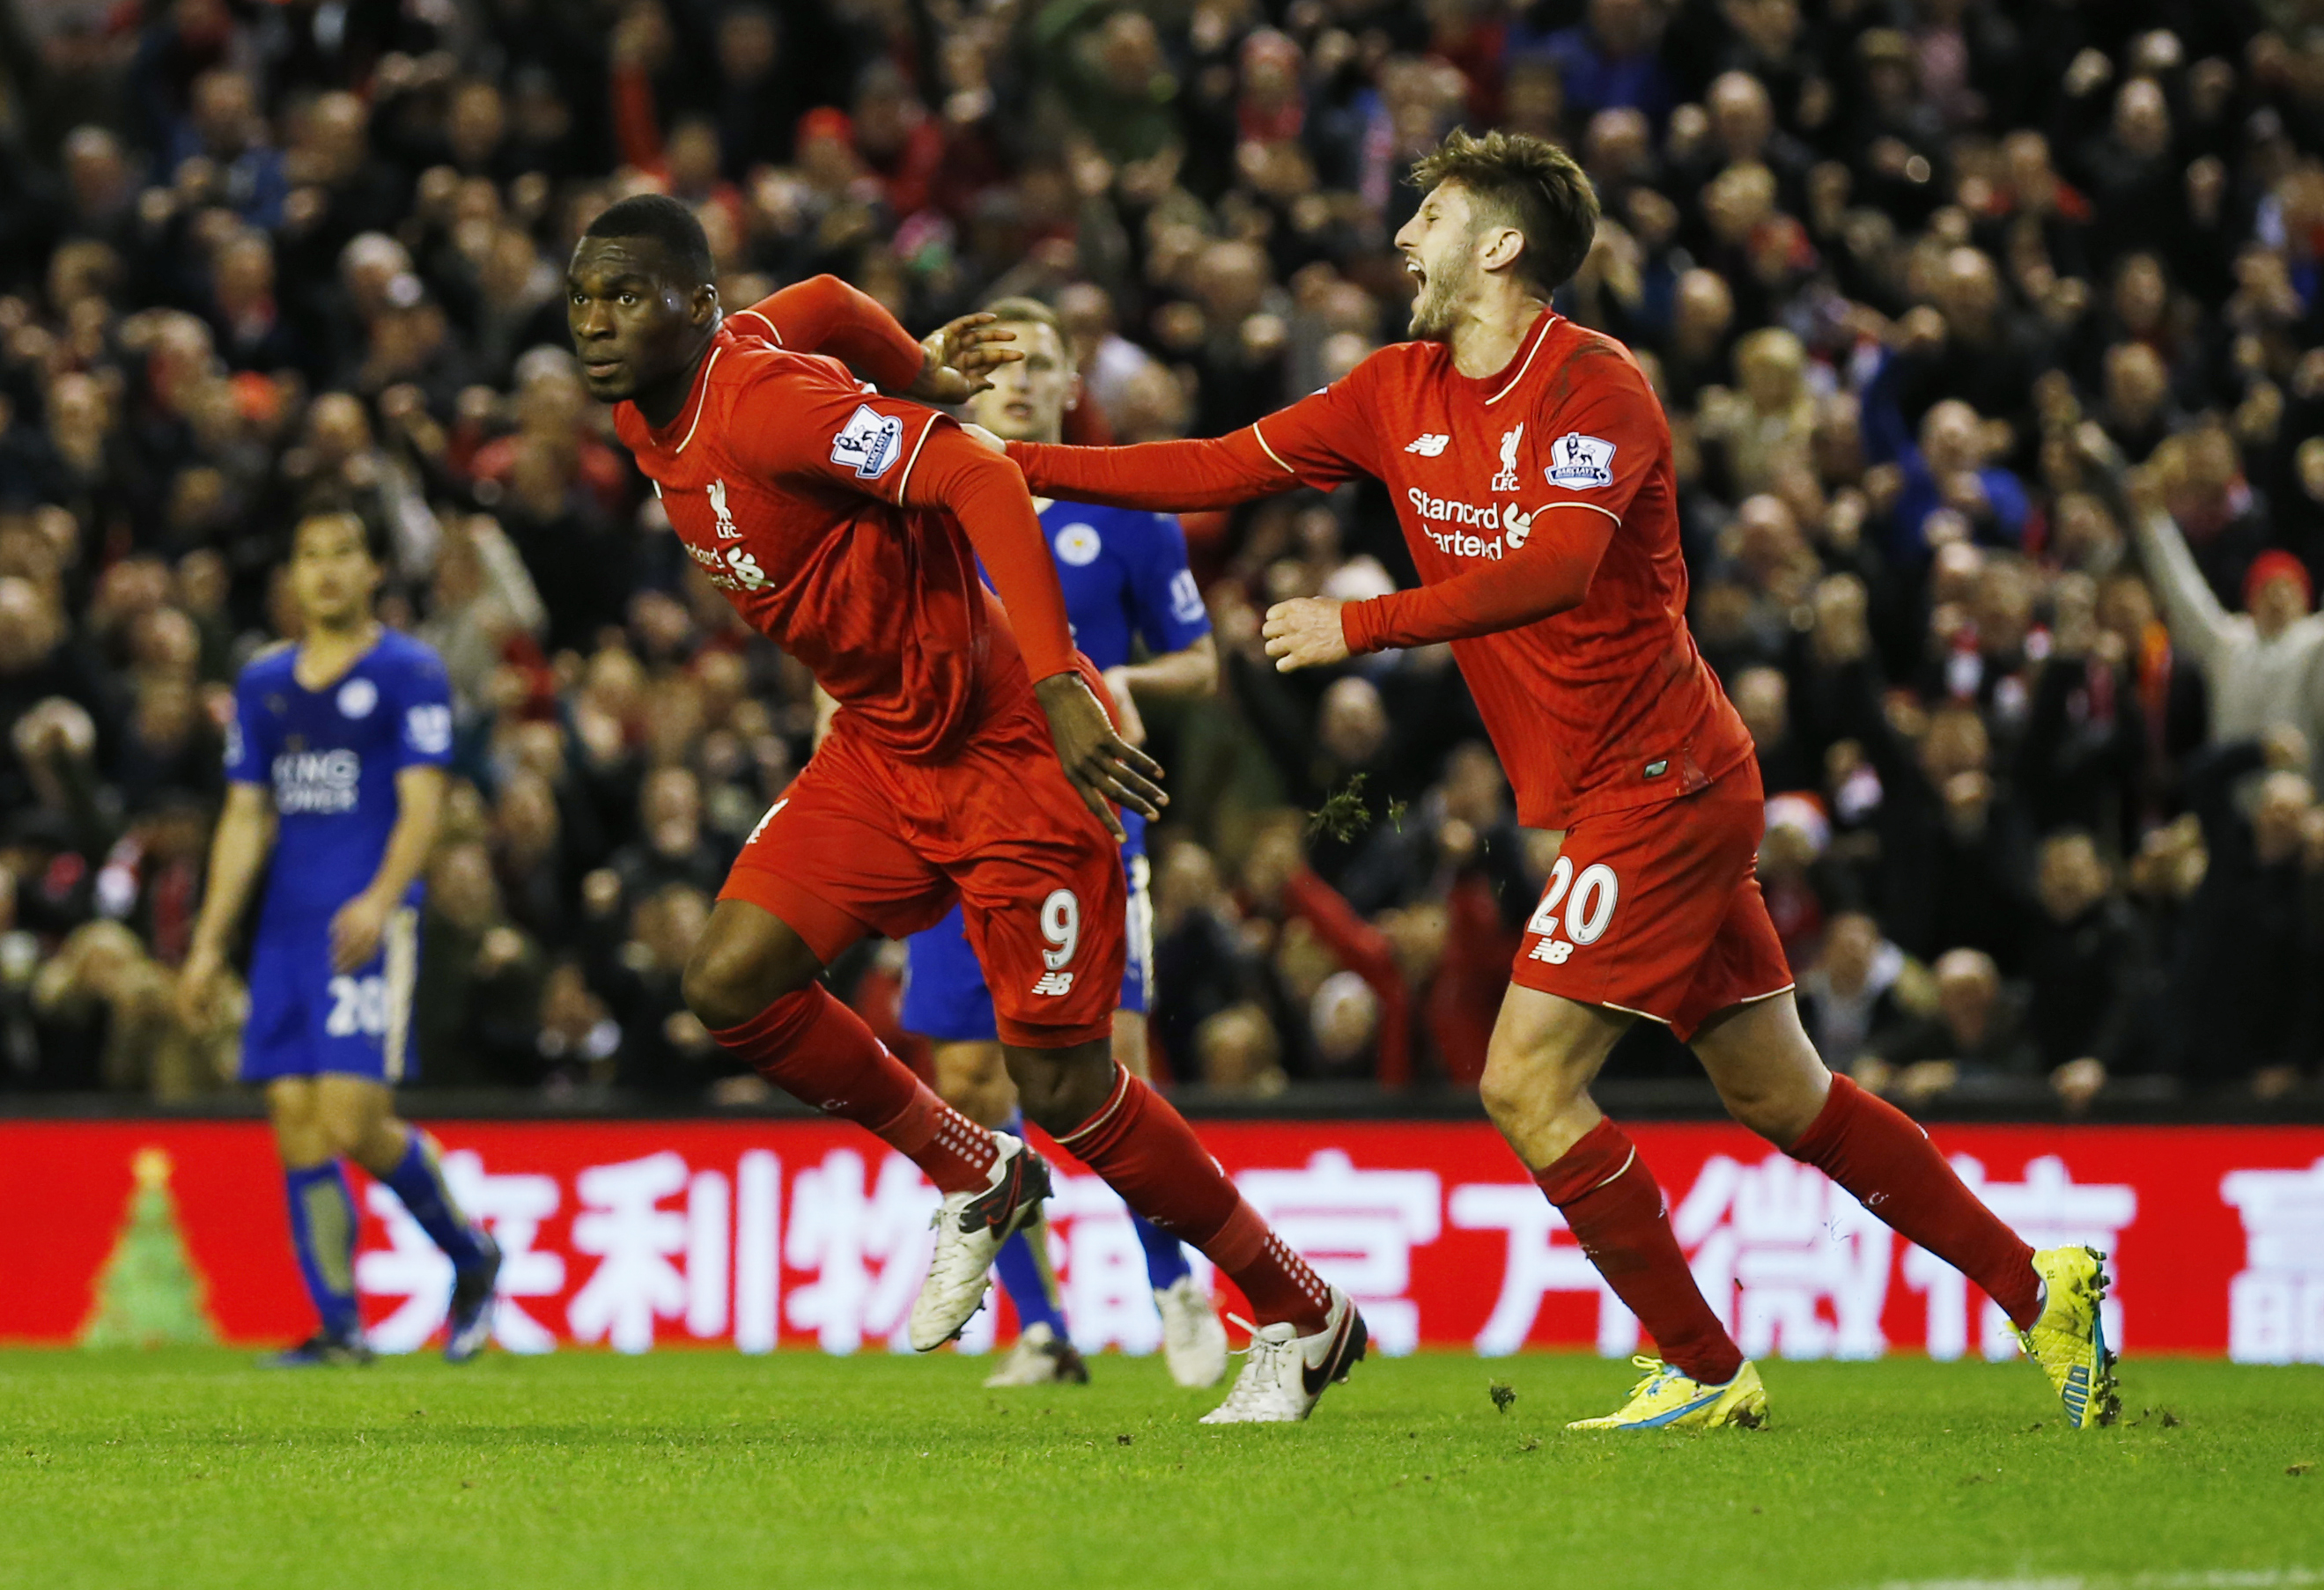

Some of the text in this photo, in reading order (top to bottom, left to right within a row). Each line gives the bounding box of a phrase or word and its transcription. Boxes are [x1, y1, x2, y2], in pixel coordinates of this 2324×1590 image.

[1408, 487, 1499, 529] Standrd
[1040, 888, 1080, 970] 9
[1527, 856, 1619, 945] 20
[325, 975, 391, 1037] 20
